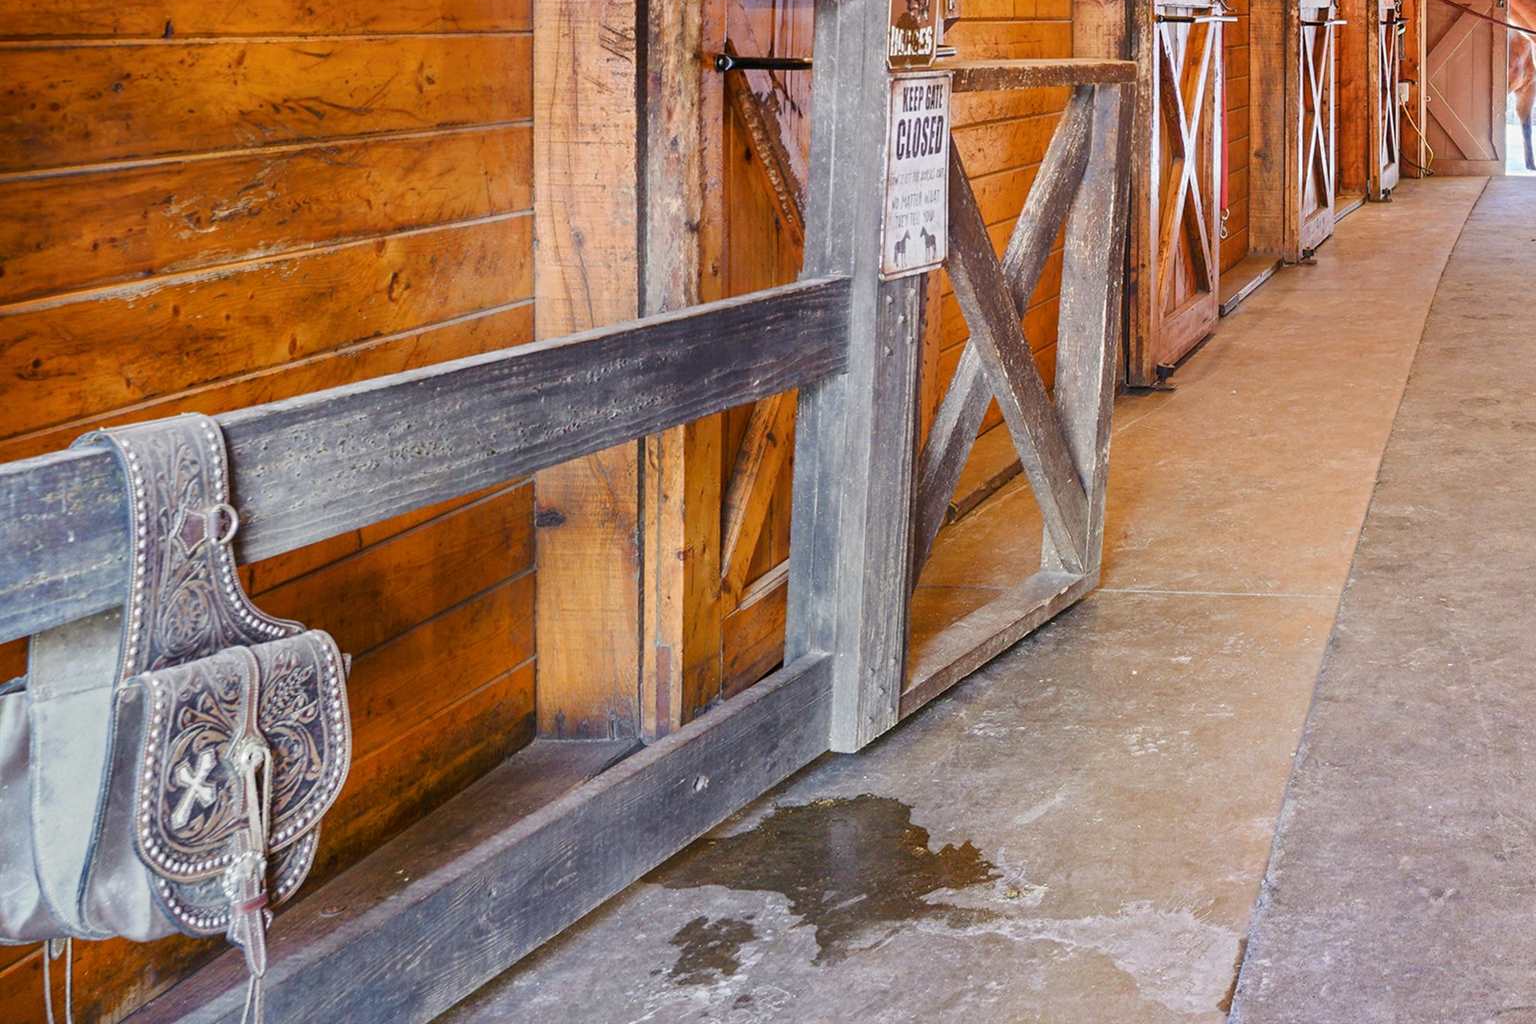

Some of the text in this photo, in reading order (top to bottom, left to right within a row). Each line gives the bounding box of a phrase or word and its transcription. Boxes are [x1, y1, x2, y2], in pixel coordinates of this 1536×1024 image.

[903, 84, 944, 113] KEEP GATE
[896, 115, 945, 161] CLOSED
